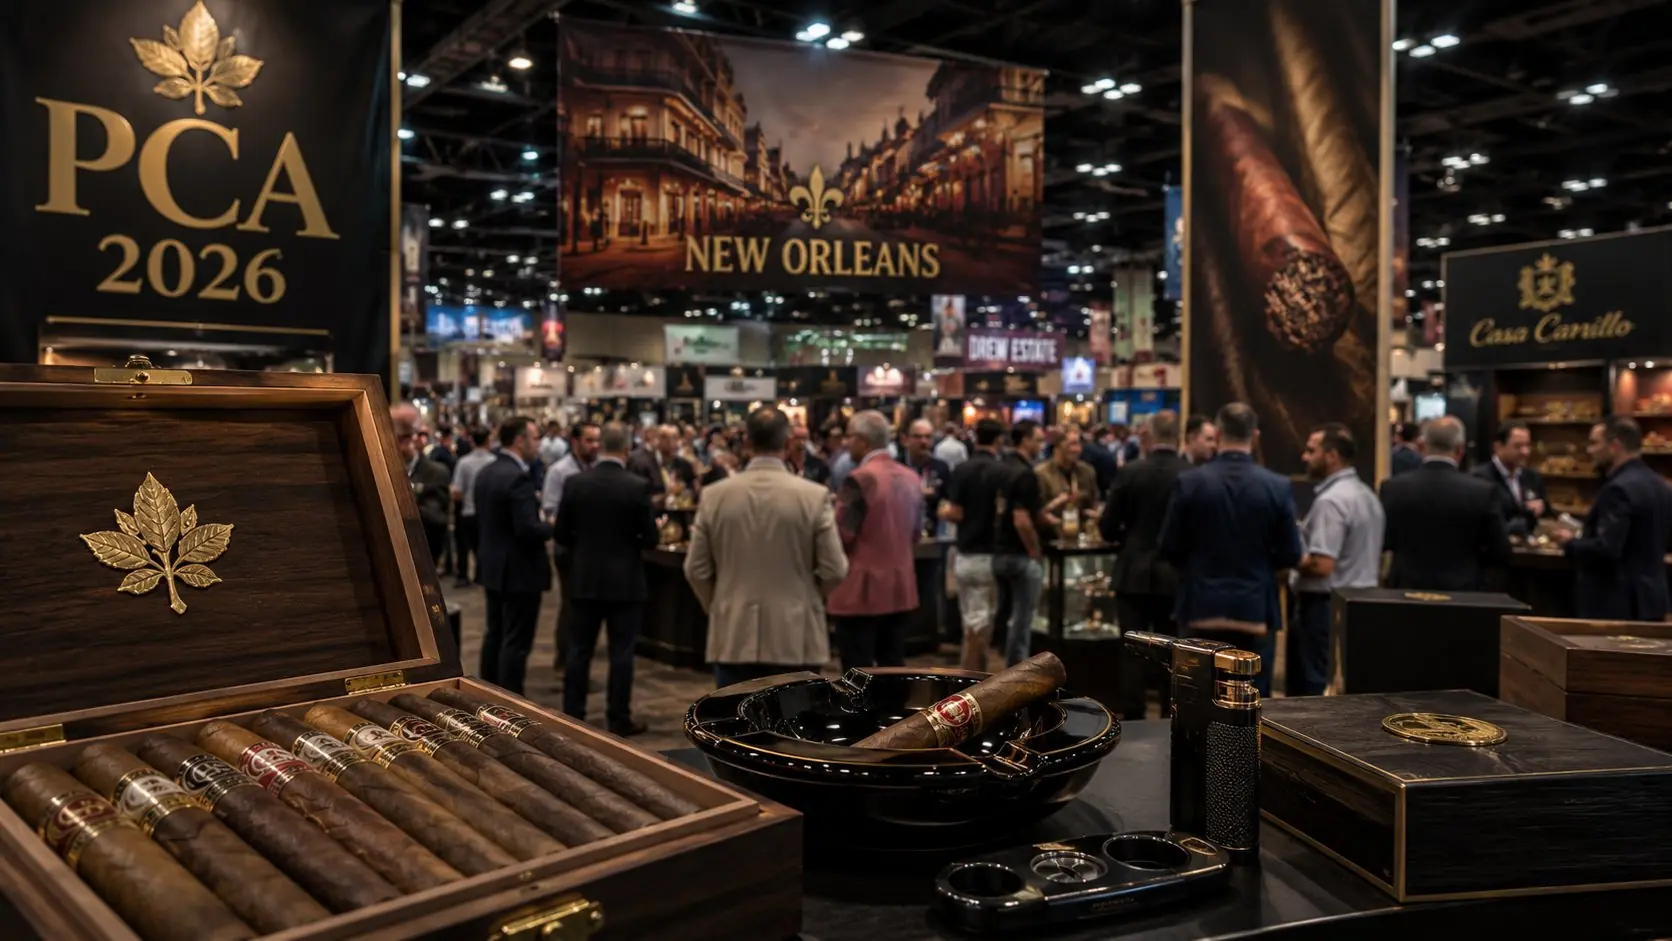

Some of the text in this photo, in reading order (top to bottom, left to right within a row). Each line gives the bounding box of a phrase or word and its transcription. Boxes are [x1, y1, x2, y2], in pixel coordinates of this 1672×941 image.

[35, 97, 340, 239] PCA
[96, 234, 286, 304] 2026
[684, 235, 941, 278] NEW ORLEANS
[968, 335, 1058, 363] DREW ESTATE
[1469, 317, 1529, 347] Casa
